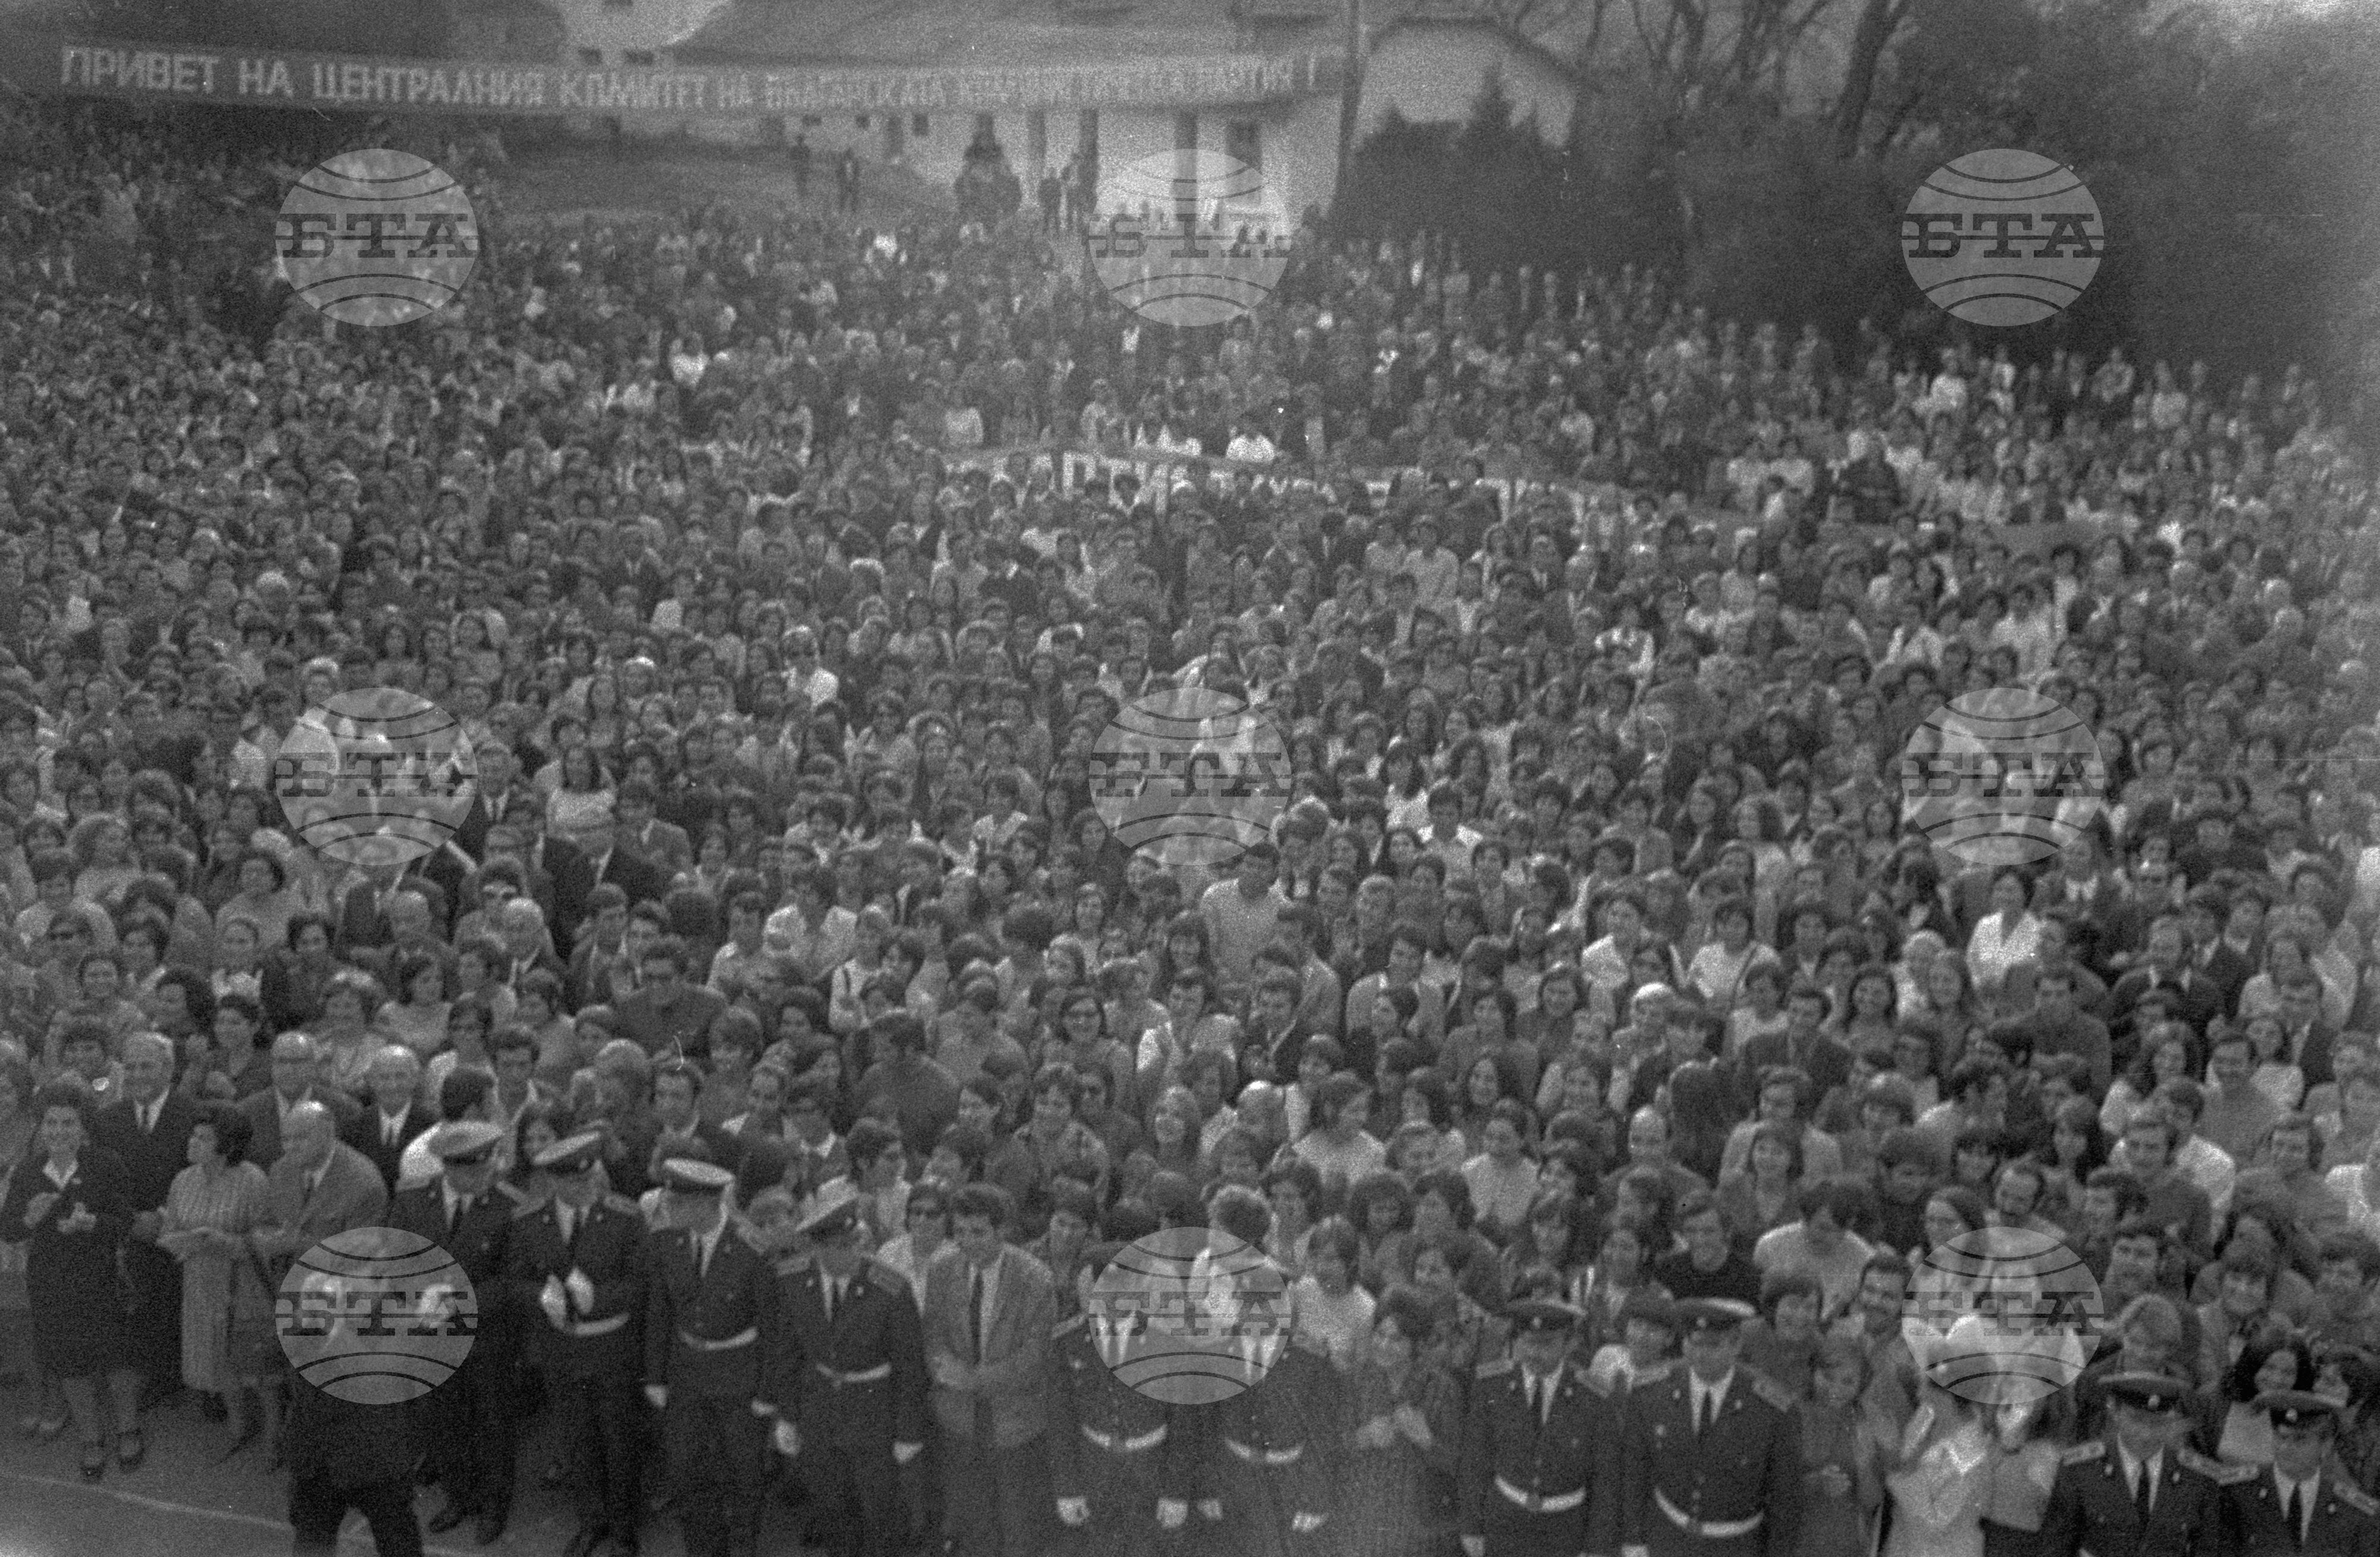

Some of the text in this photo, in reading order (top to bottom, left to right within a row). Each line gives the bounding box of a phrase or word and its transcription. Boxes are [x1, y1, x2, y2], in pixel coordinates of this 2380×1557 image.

[60, 45, 220, 93] ПРИВЕТ
[238, 58, 294, 98] НА
[312, 62, 544, 106] ЦЕНТРАЛНИЯ
